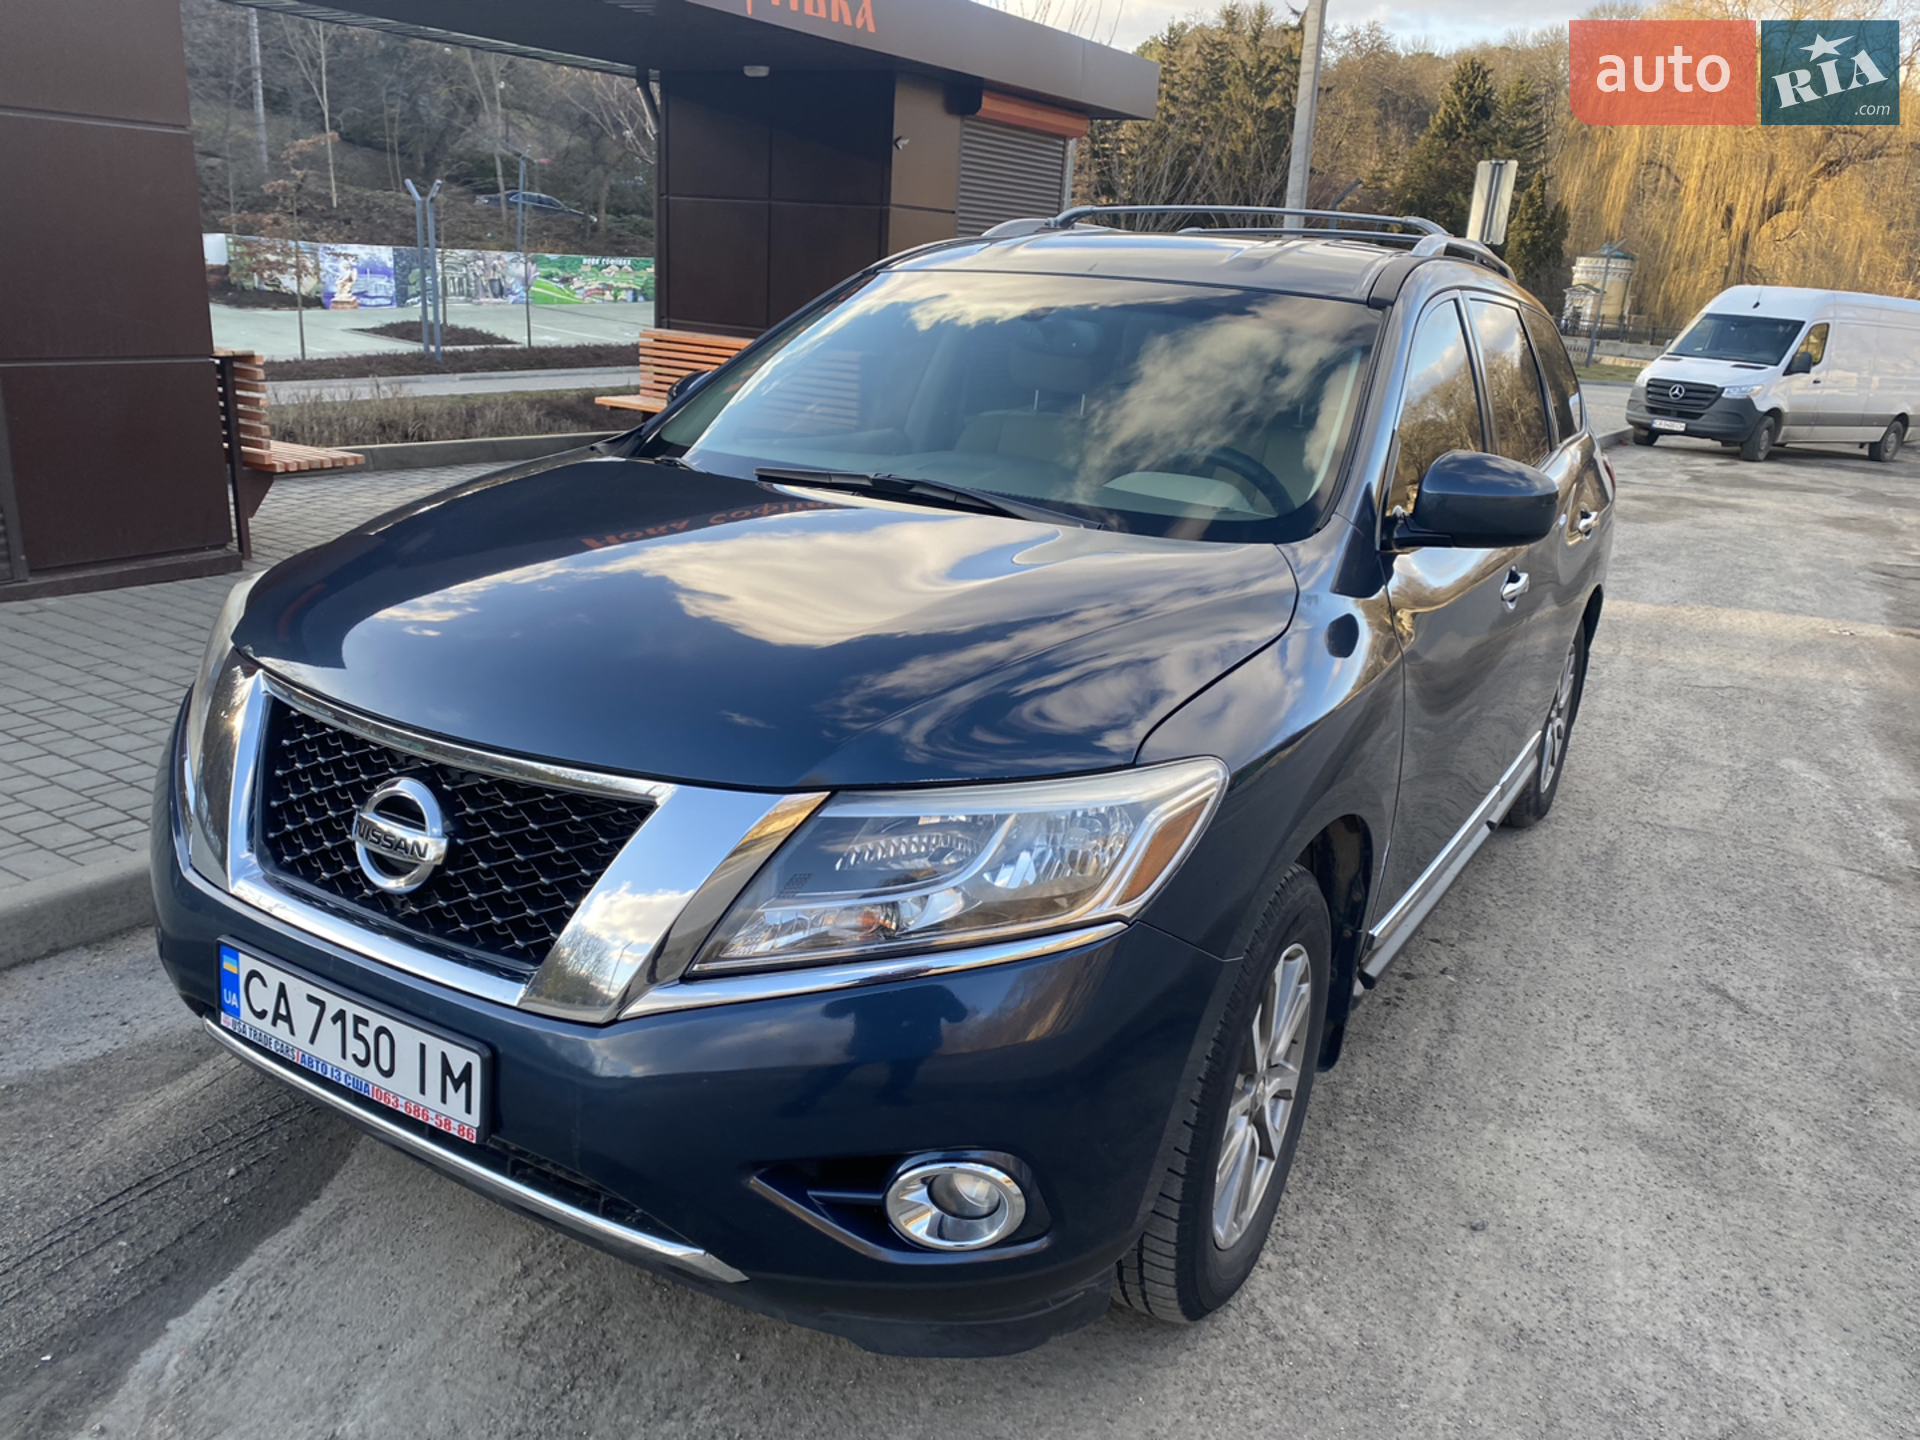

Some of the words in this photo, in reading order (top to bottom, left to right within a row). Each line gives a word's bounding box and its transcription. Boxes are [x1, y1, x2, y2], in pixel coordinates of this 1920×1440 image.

[358, 822, 429, 859] NISSAN
[223, 988, 239, 1009] UA
[231, 1018, 248, 1037] USA
[248, 1027, 273, 1049] TRADE
[273, 1039, 296, 1062] CARS
[243, 968, 296, 1037] CA
[306, 993, 396, 1079] 7150
[301, 1053, 328, 1077] АВТО
[344, 1074, 371, 1096] США
[373, 1086, 475, 1143] 063-686-58-86
